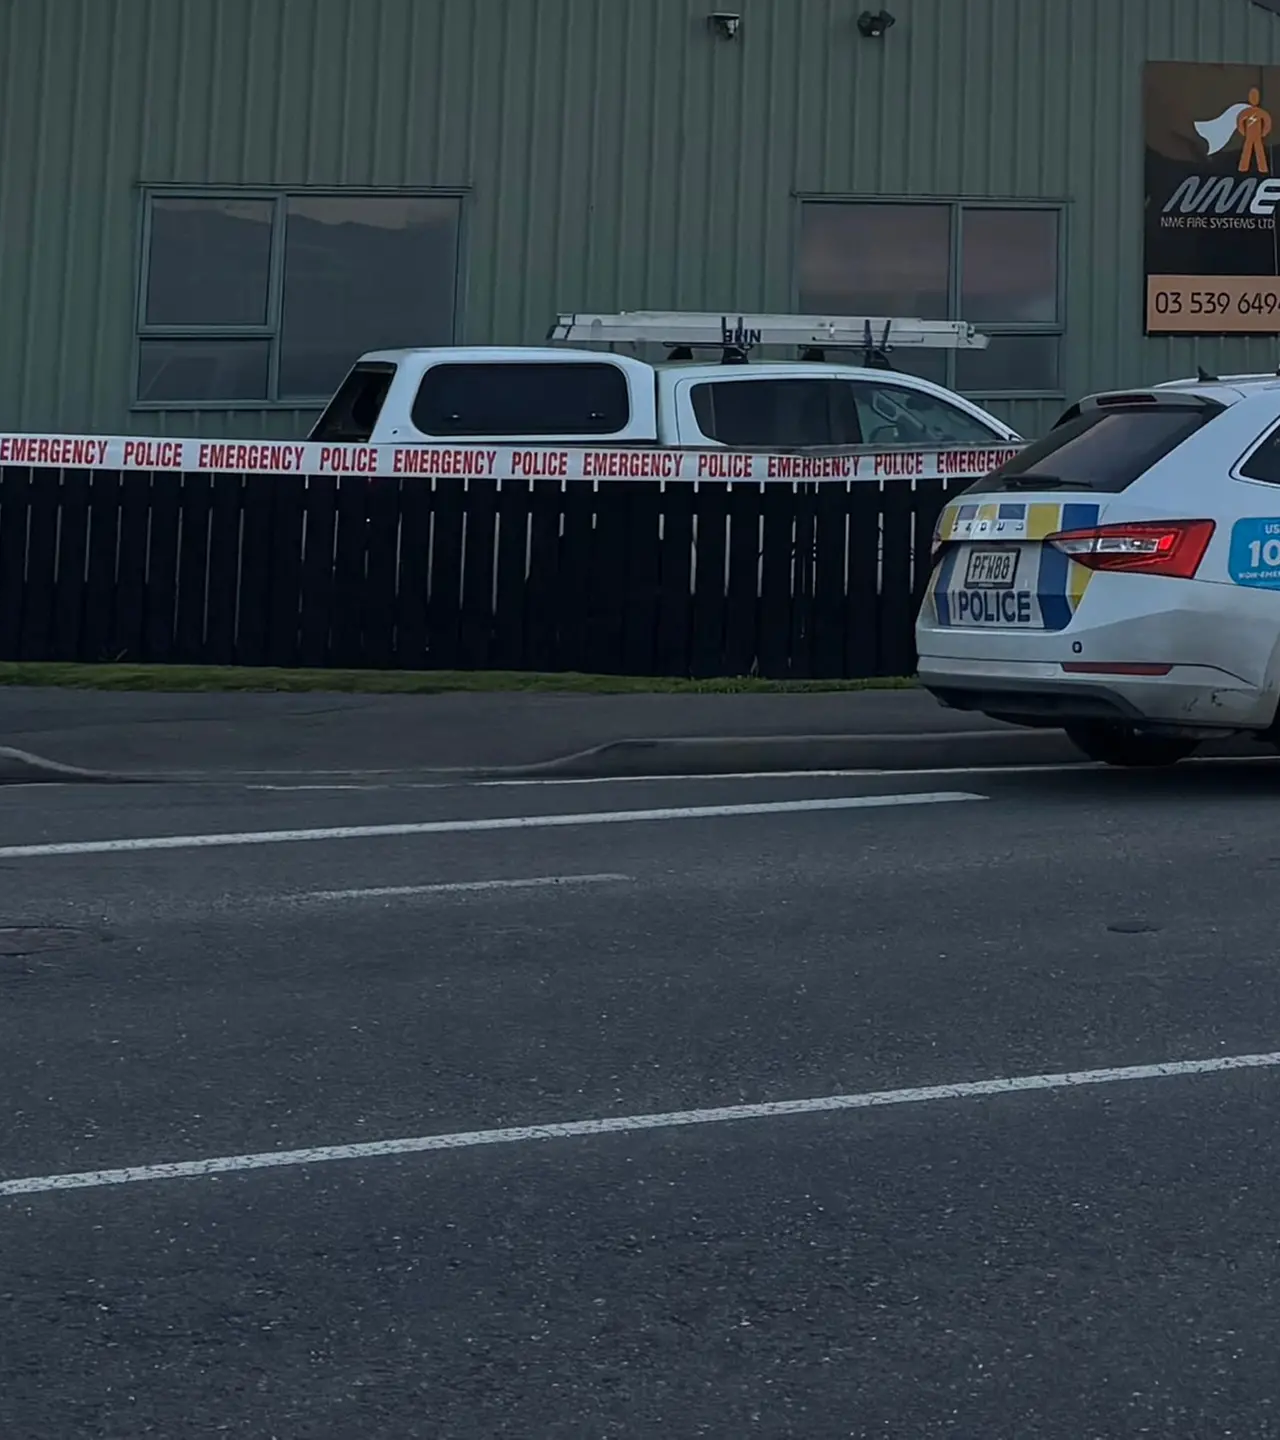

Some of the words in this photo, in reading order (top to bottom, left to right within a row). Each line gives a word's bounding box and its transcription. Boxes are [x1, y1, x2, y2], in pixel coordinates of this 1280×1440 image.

[1161, 217, 1185, 228] NME
[1187, 217, 1208, 228] FIRE
[1210, 218, 1255, 229] SYSTEMS
[1258, 219, 1276, 229] LTD
[1155, 292, 1182, 315] 03
[1190, 293, 1230, 315] 539
[0, 438, 108, 464] EMERGENCY
[123, 441, 183, 467] POLICE
[198, 443, 305, 470] EMERGENCY
[320, 447, 378, 472] POLICE
[392, 449, 497, 475] EMERGENCY
[511, 451, 568, 476] POLICE
[582, 453, 684, 477] EMERGENCY
[698, 455, 752, 477] POLICE
[767, 455, 860, 477] EMERGENCY
[874, 453, 923, 475] POLICE
[959, 591, 1031, 622] POLICE
